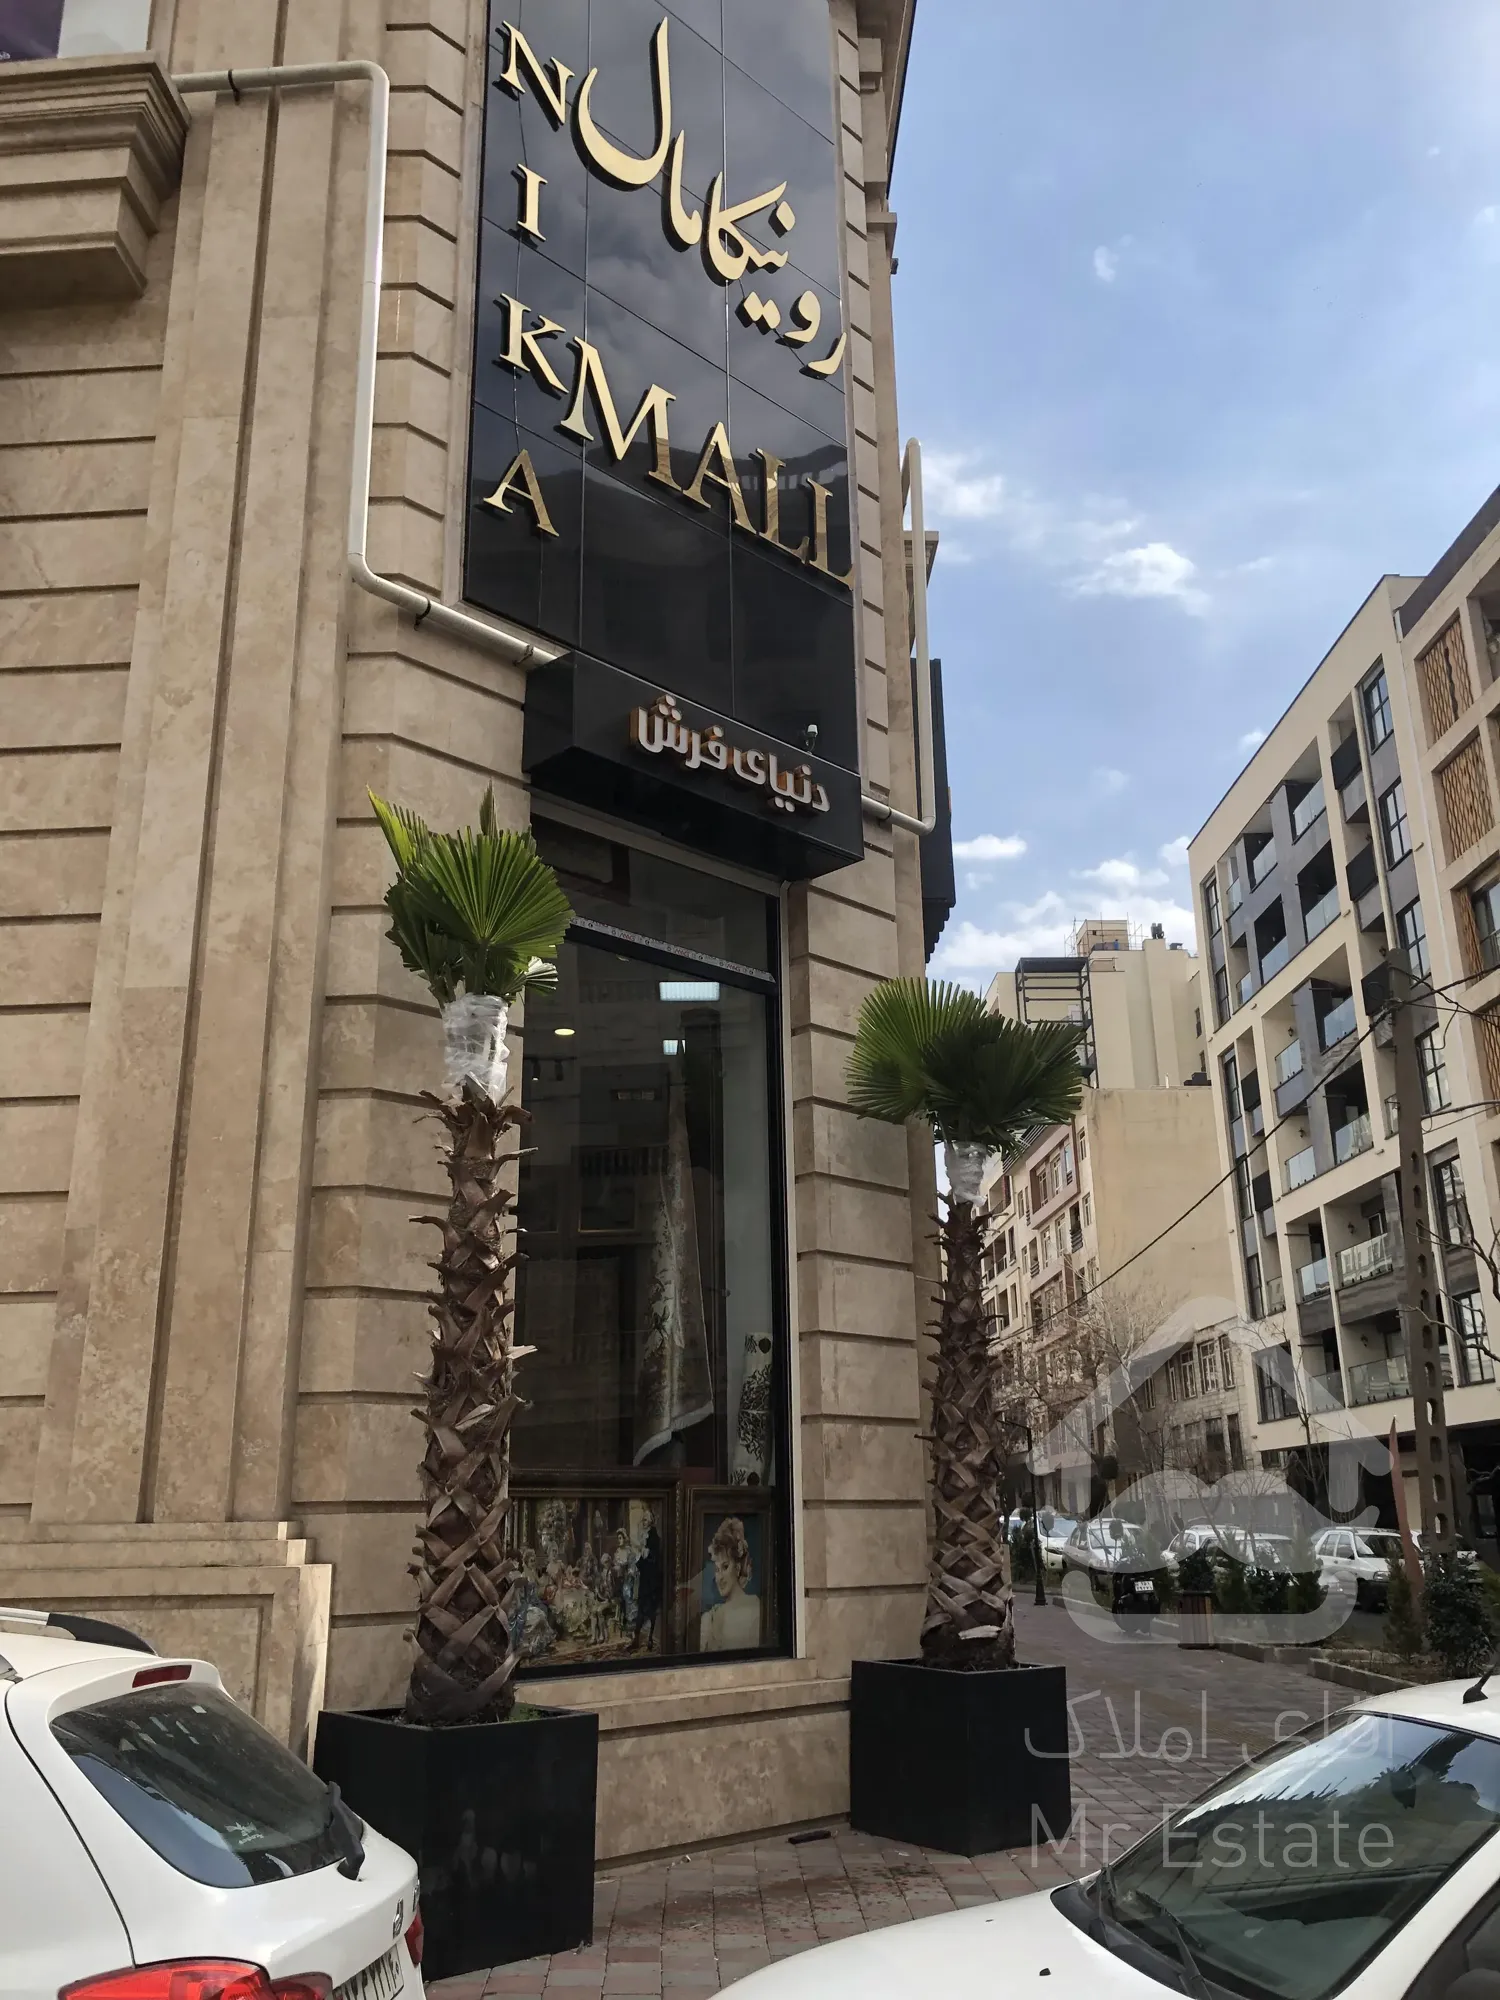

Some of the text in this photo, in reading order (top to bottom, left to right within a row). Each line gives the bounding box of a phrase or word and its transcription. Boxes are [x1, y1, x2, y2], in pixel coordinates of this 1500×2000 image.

[560, 335, 854, 591] MALL
[631, 693, 831, 813] دنیای فرش
